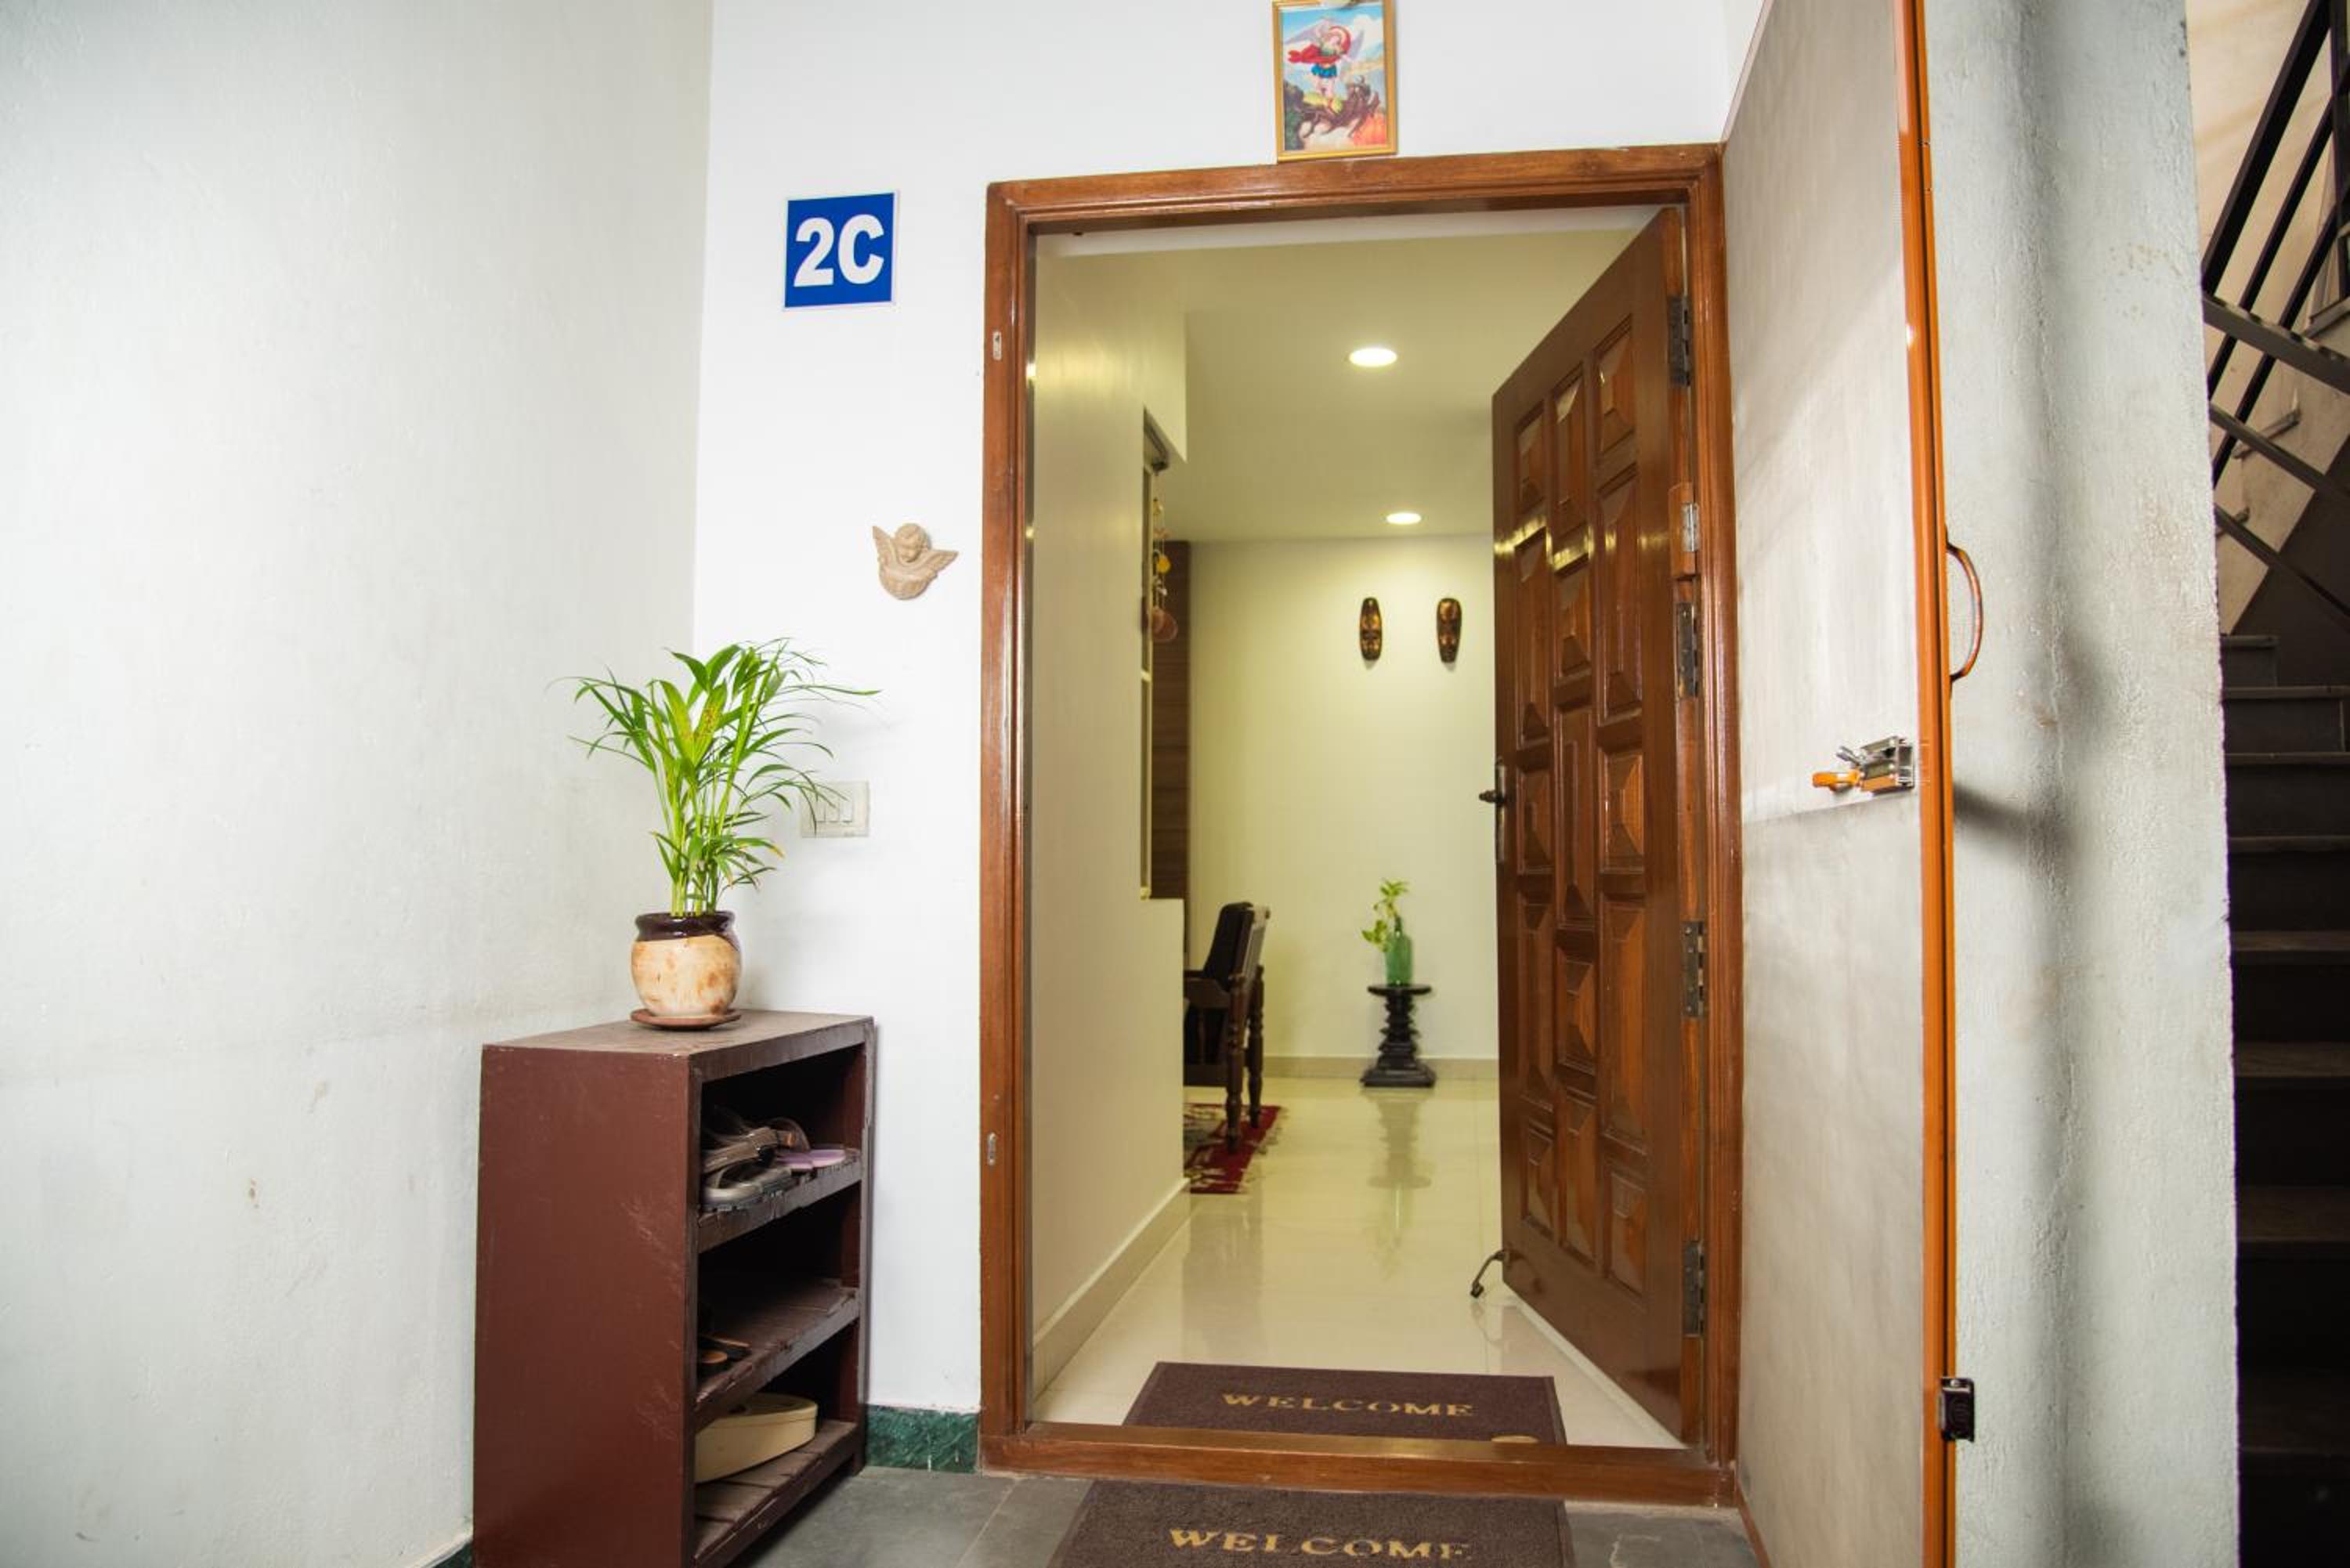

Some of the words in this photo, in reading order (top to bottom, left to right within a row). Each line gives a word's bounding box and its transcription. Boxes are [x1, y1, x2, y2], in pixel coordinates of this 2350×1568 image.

[794, 214, 884, 287] 2C
[1222, 1394, 1474, 1418] WELCOME
[1169, 1528, 1472, 1560] WELCOME
